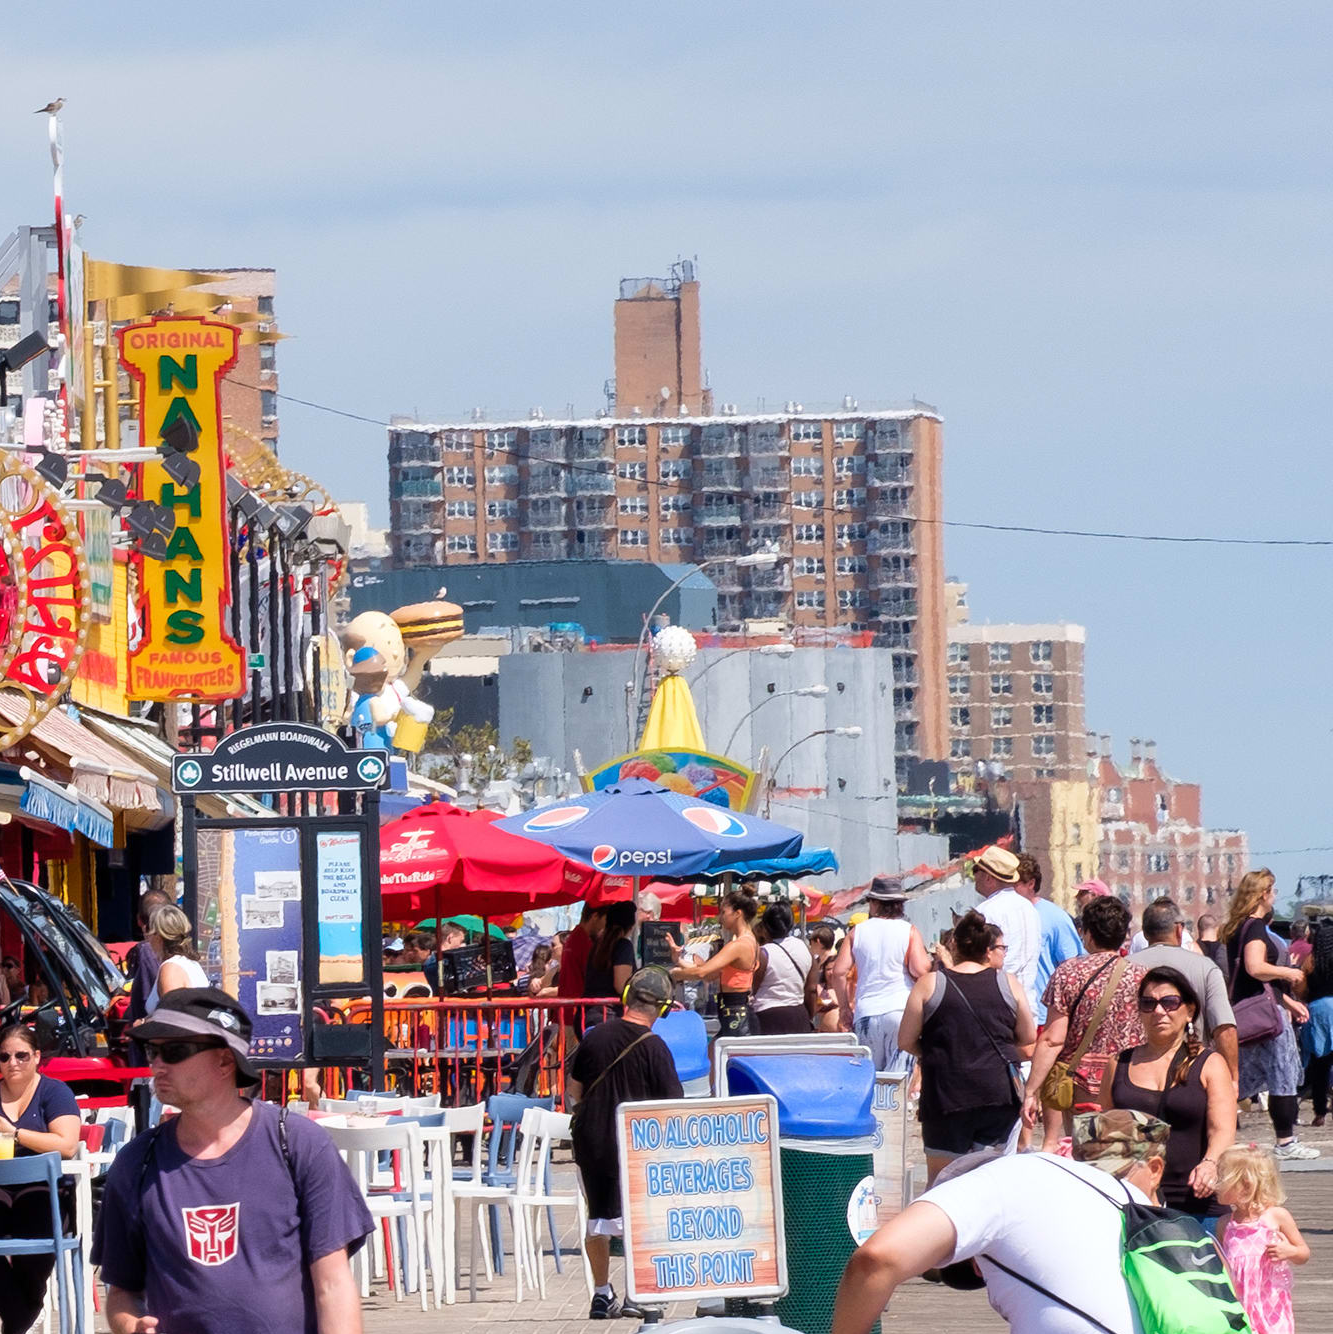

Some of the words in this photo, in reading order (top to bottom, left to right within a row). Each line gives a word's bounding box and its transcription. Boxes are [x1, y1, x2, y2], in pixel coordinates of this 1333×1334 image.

[130, 332, 224, 349] ORIGINAL
[158, 354, 205, 645] NAHANS
[148, 651, 222, 664] FAMOUS
[136, 664, 234, 690] FRANKFURTERS
[228, 732, 278, 754] RIEGELMANN
[279, 731, 331, 753] BOARDWALK
[211, 763, 281, 782] Stillwell
[285, 763, 348, 781] Avenue
[619, 849, 673, 867] pepsi
[631, 1117, 663, 1150] NO
[664, 1111, 769, 1149] ALCOHOLIC
[646, 1158, 753, 1197] BEVERAGES
[667, 1206, 743, 1241] BEYOND
[652, 1253, 697, 1288] THIS
[700, 1250, 756, 1286] POINT
